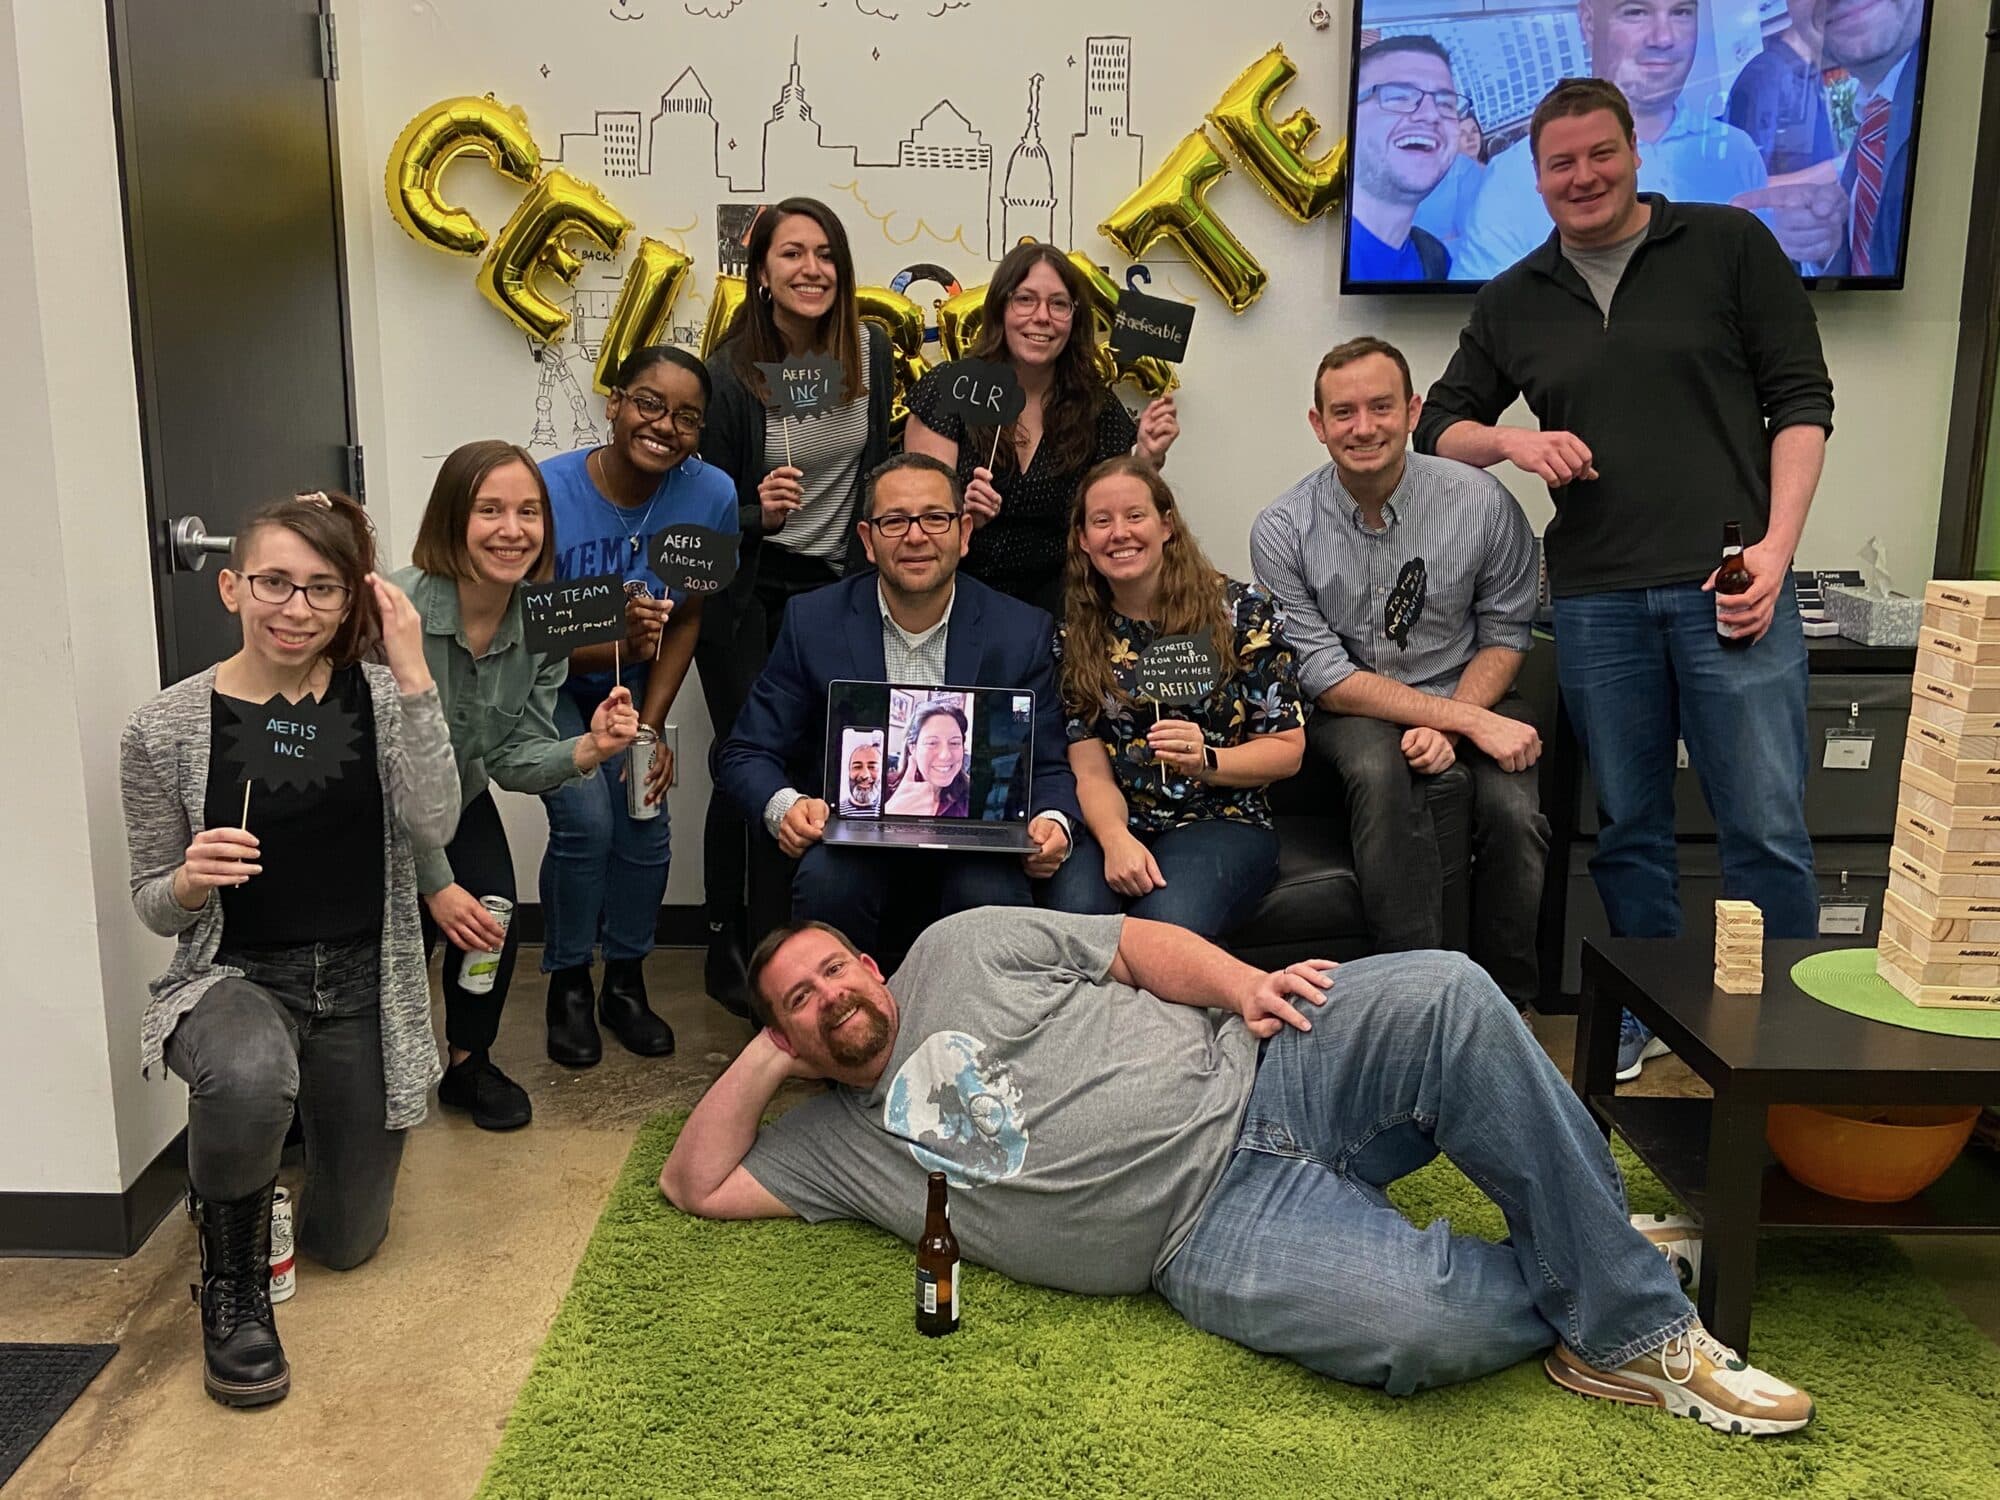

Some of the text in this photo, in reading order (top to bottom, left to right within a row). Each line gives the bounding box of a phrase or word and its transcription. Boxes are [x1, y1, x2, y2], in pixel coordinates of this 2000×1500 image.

[782, 368, 821, 381] AEFIS
[952, 375, 1004, 413] CLR
[664, 534, 702, 549] AEFIS
[660, 551, 714, 571] ACADEMY
[683, 576, 718, 590] 2020
[526, 592, 553, 609] MY
[560, 585, 610, 604] TEAM
[1153, 641, 1194, 655] STARTED
[1143, 656, 1171, 665] FROM
[1159, 682, 1197, 697] AEFIS
[1197, 681, 1215, 695] INC
[266, 718, 317, 740] AEFIS
[274, 741, 305, 758] INC
